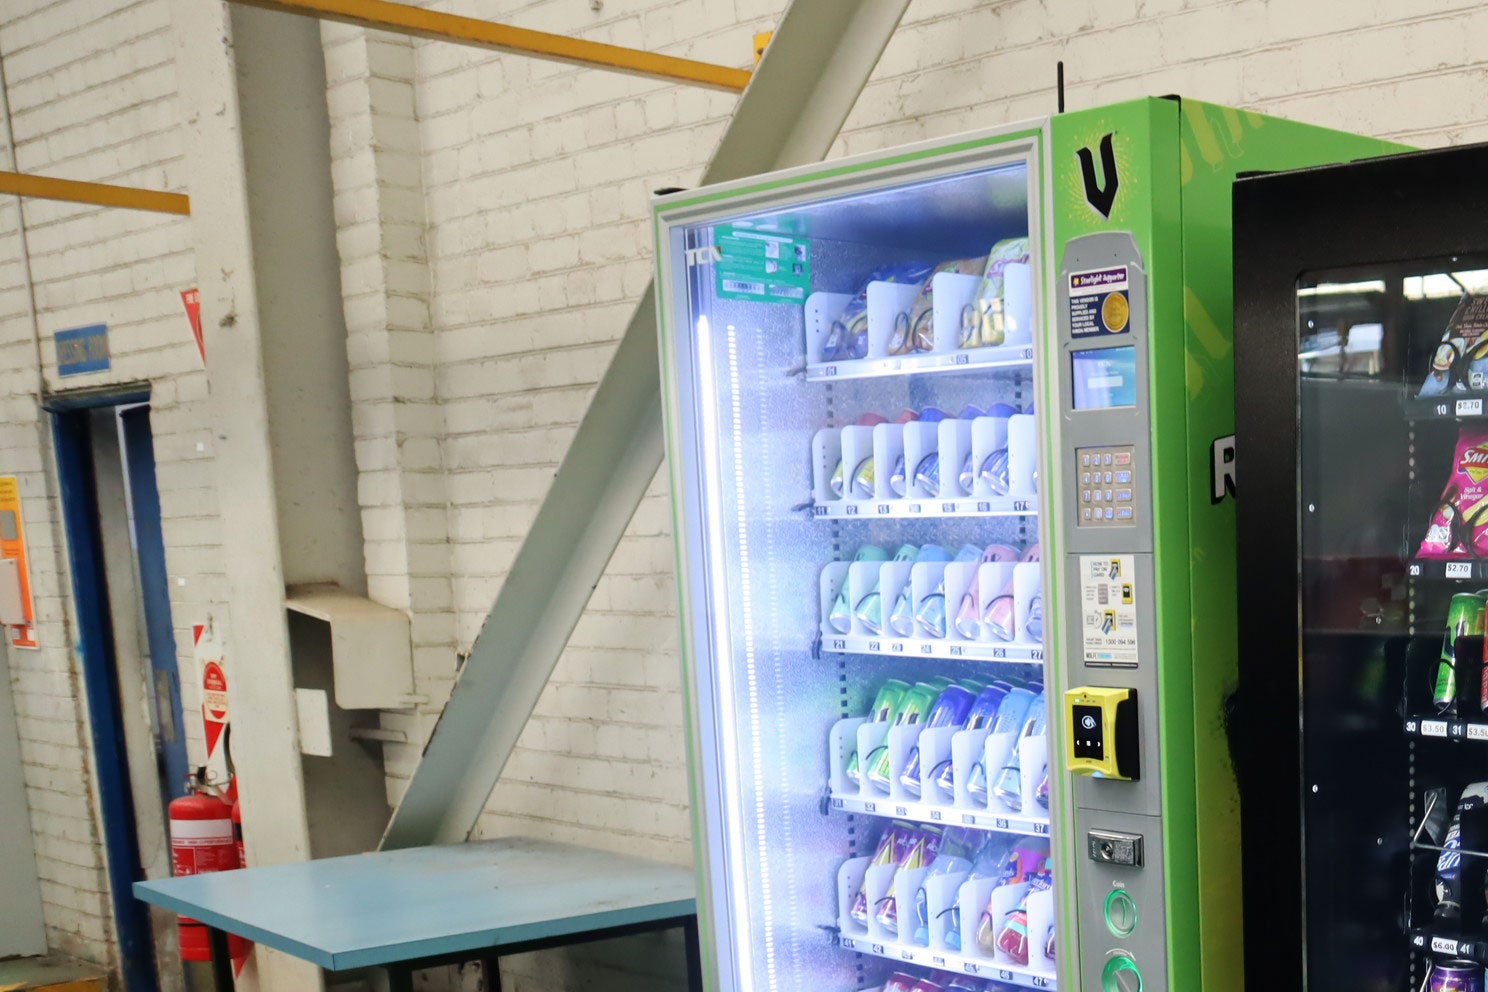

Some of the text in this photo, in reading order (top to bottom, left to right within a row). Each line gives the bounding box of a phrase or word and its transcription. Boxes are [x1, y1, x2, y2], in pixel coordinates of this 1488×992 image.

[1076, 132, 1119, 220] V
[1437, 405, 1446, 415] 10
[1015, 501, 1025, 510] 17
[1410, 566, 1420, 576] 20
[1447, 565, 1469, 573] $2.70
[1406, 721, 1416, 732] 30
[1422, 725, 1444, 733] $3.50
[1453, 725, 1462, 736] 31
[1034, 822, 1045, 833] 37
[1113, 880, 1125, 888] Coin
[1414, 936, 1424, 946] 40
[1434, 942, 1454, 950] $6.00
[1460, 944, 1470, 953] 41
[1033, 976, 1044, 986] 47
